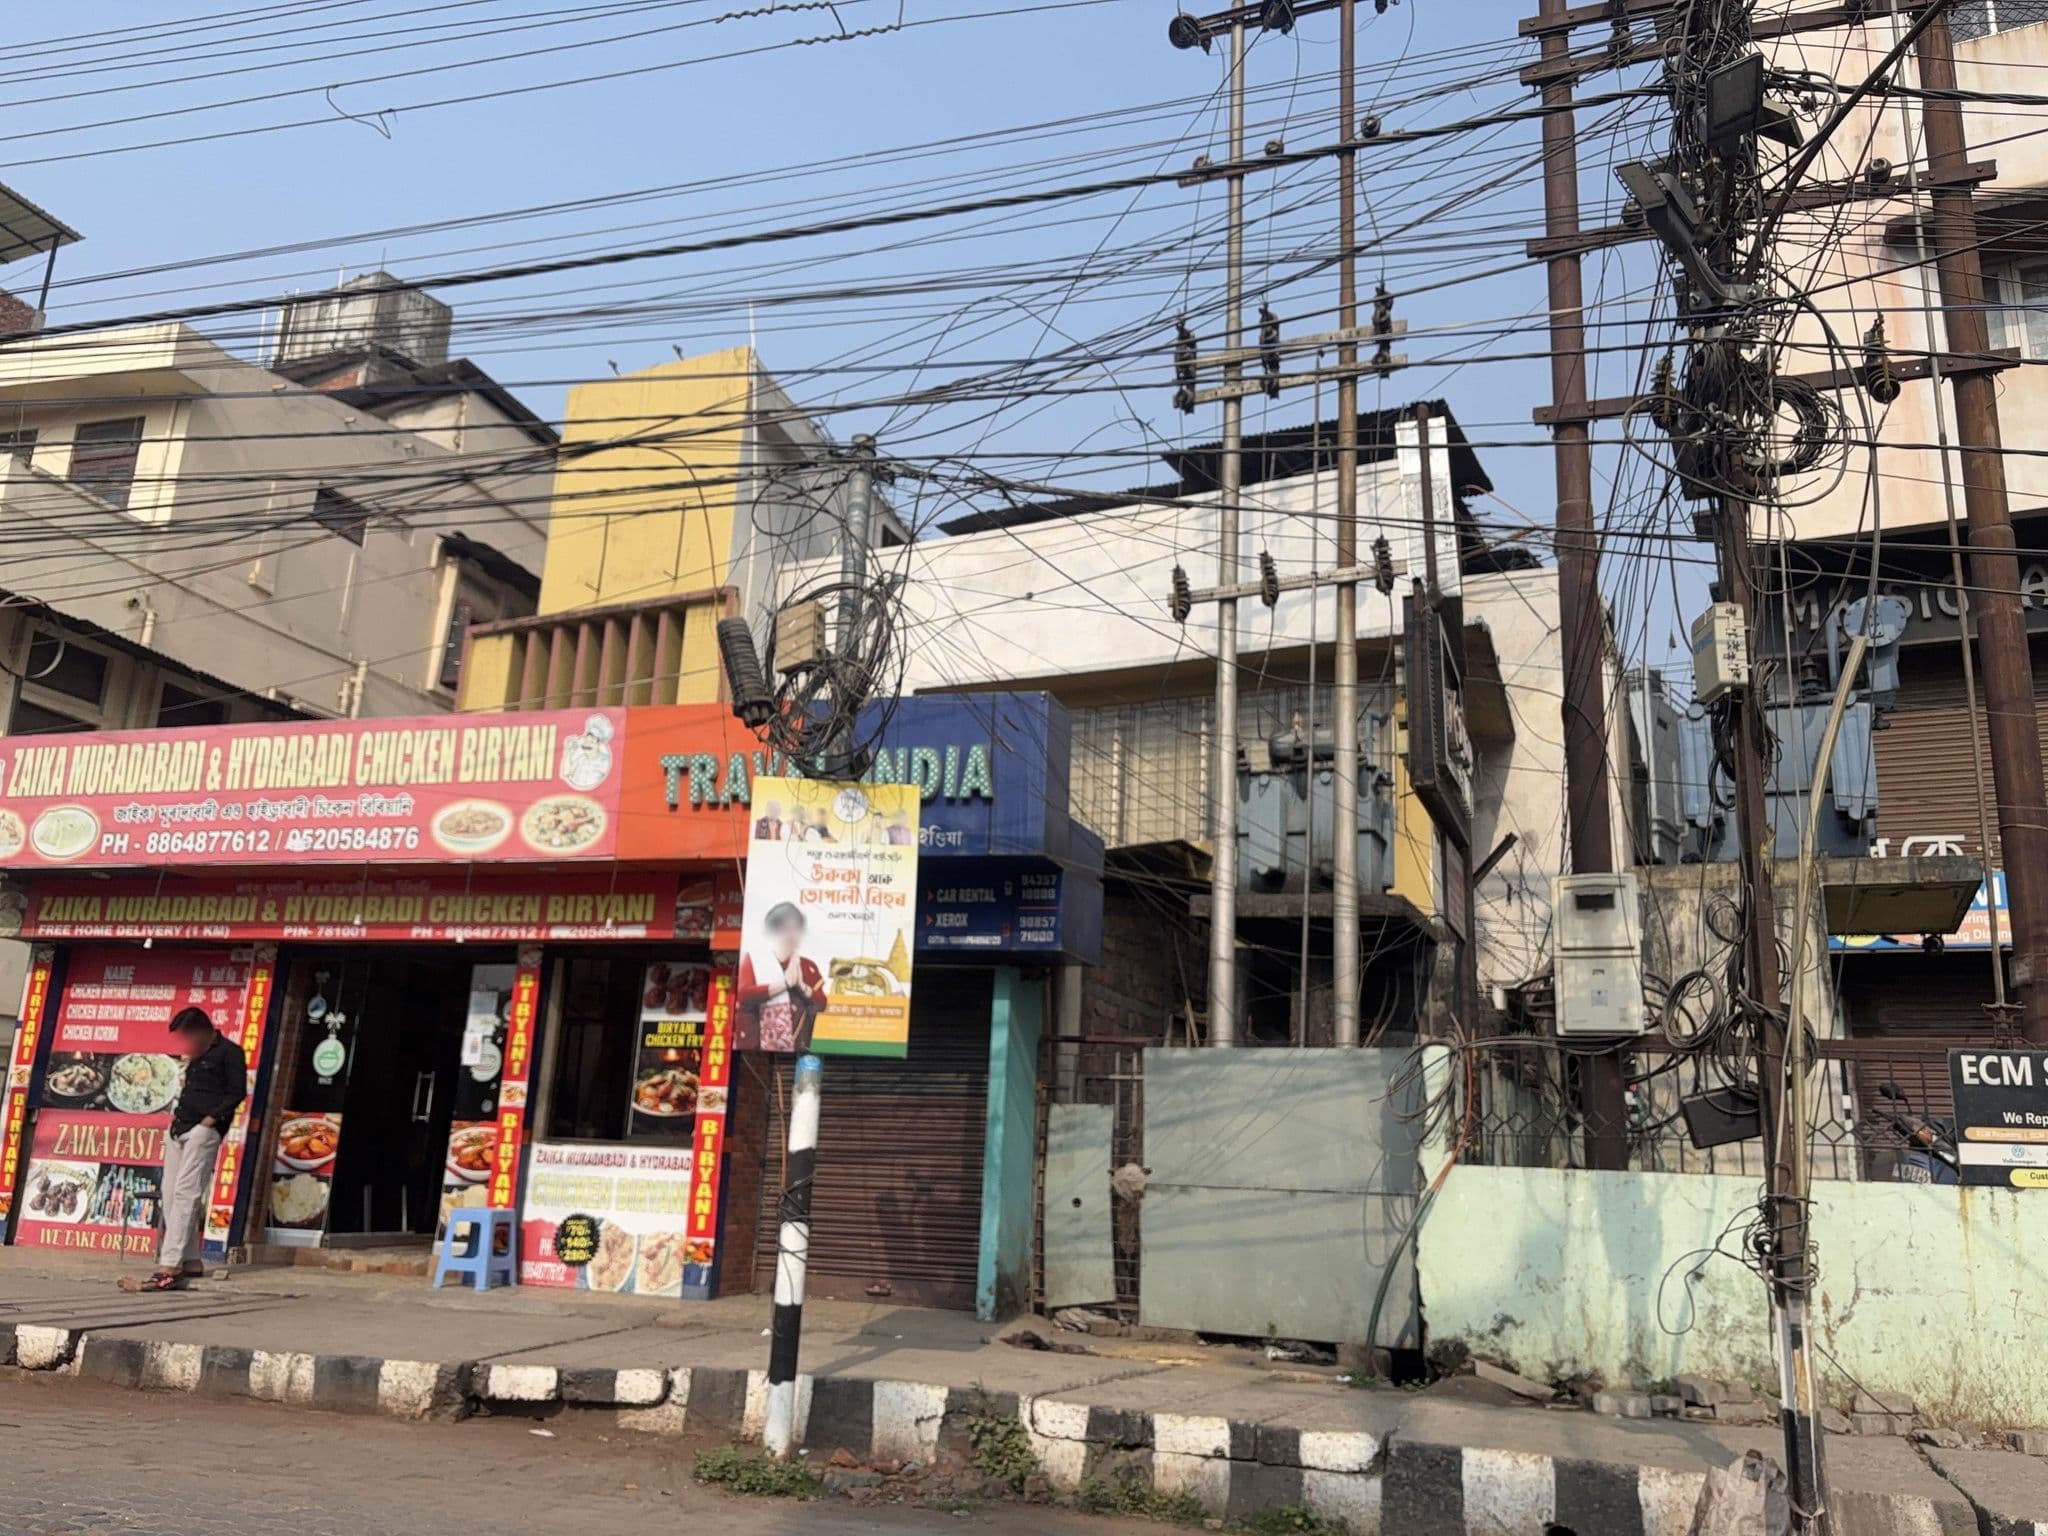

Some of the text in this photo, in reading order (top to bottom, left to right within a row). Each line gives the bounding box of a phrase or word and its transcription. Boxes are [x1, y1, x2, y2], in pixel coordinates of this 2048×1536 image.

[6, 724, 557, 798] ZAIKA MURADABADI & HYDRABADI CHICKEN BIRYANI
[100, 833, 130, 855] PH
[145, 829, 270, 856] 8864877612
[38, 893, 656, 923] ZAIKA MURADABADI & HYDRABADI CHICKEN BIRYANI
[935, 913, 968, 927] XEROX
[37, 925, 71, 937] FREE
[74, 925, 113, 937] HOME
[116, 925, 183, 937] DELIVERY
[202, 925, 230, 938] KM)
[411, 926, 433, 938] PH
[105, 966, 135, 980] NAME
[22, 968, 47, 1061] BIRYANI
[511, 974, 536, 1076] BIRYANI
[709, 974, 731, 1081] BIRYANI
[1960, 1055, 2033, 1086] ECM
[2003, 1112, 2022, 1124] We
[3, 1094, 26, 1187] BIRYANI
[53, 1123, 110, 1157] ZAIKA
[113, 1127, 159, 1160] FAST
[494, 1113, 518, 1209] BIRYAN
[696, 1119, 719, 1231] BIRYANI
[40, 1228, 151, 1253] WE TAKE ORDER
